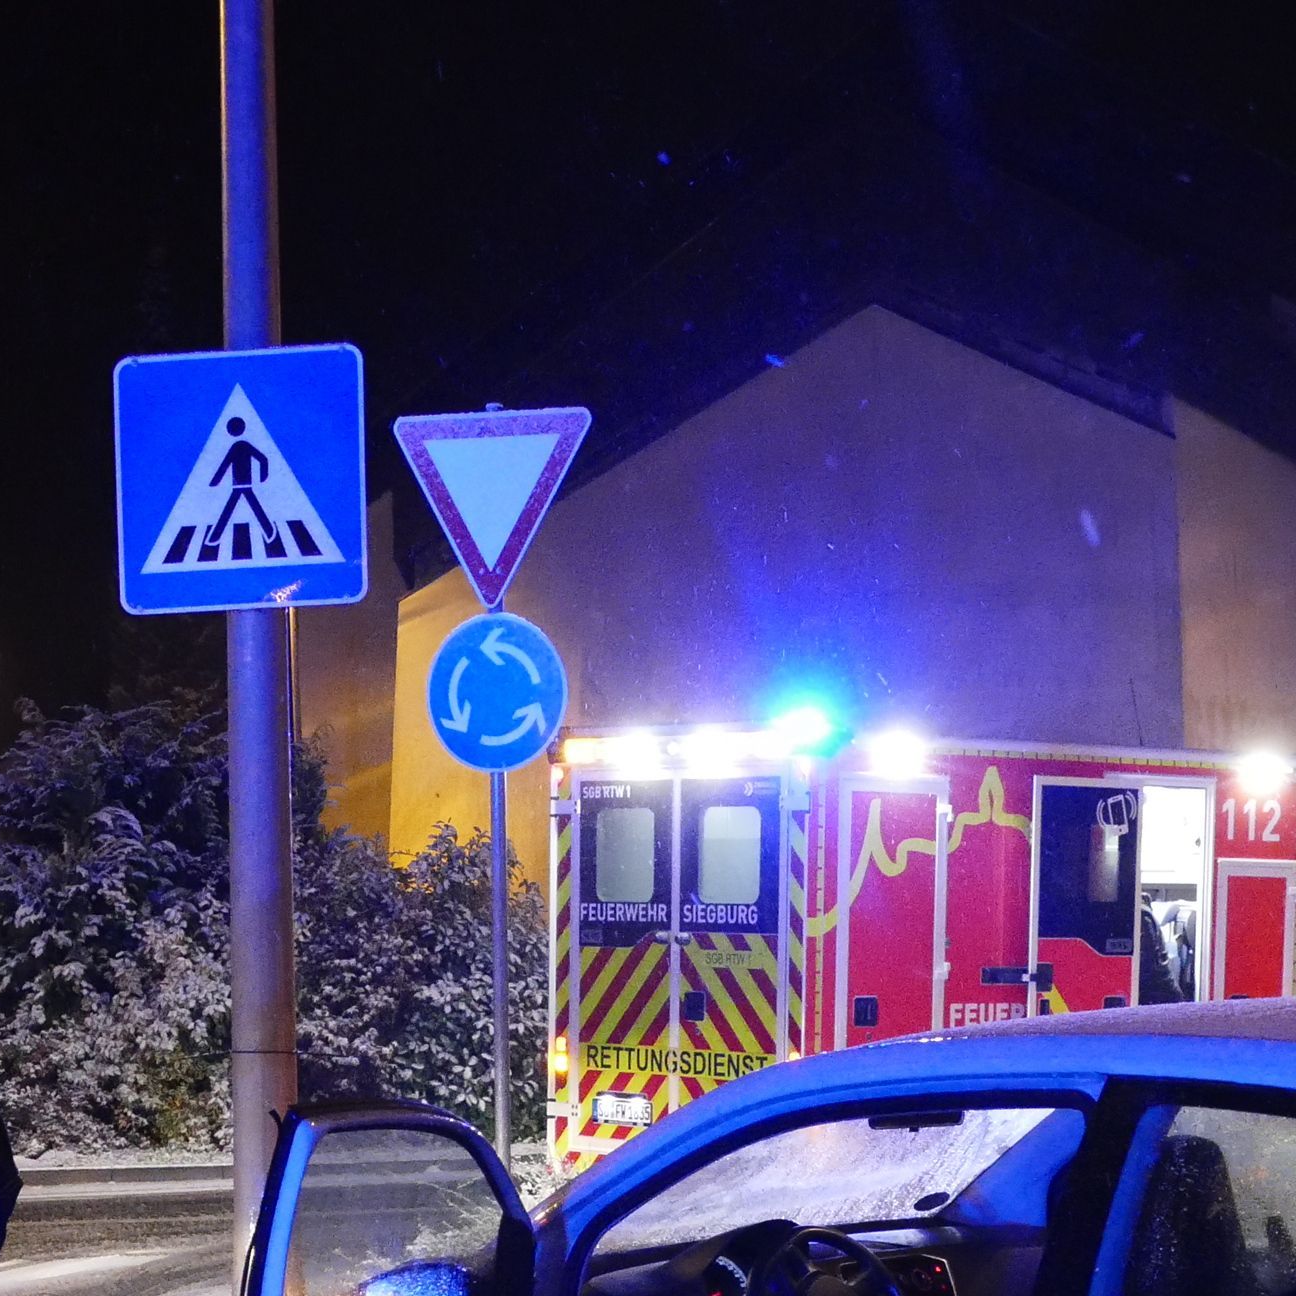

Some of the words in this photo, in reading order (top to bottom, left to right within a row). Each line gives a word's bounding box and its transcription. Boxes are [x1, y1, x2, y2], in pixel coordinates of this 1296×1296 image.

[582, 786, 602, 799] SGB
[603, 785, 625, 798] RTW
[1222, 798, 1282, 842] 112
[580, 903, 668, 922] FEUERWEHR
[683, 904, 758, 924] SIEGBURG
[586, 1045, 768, 1078] RETTUNGSDIENST
